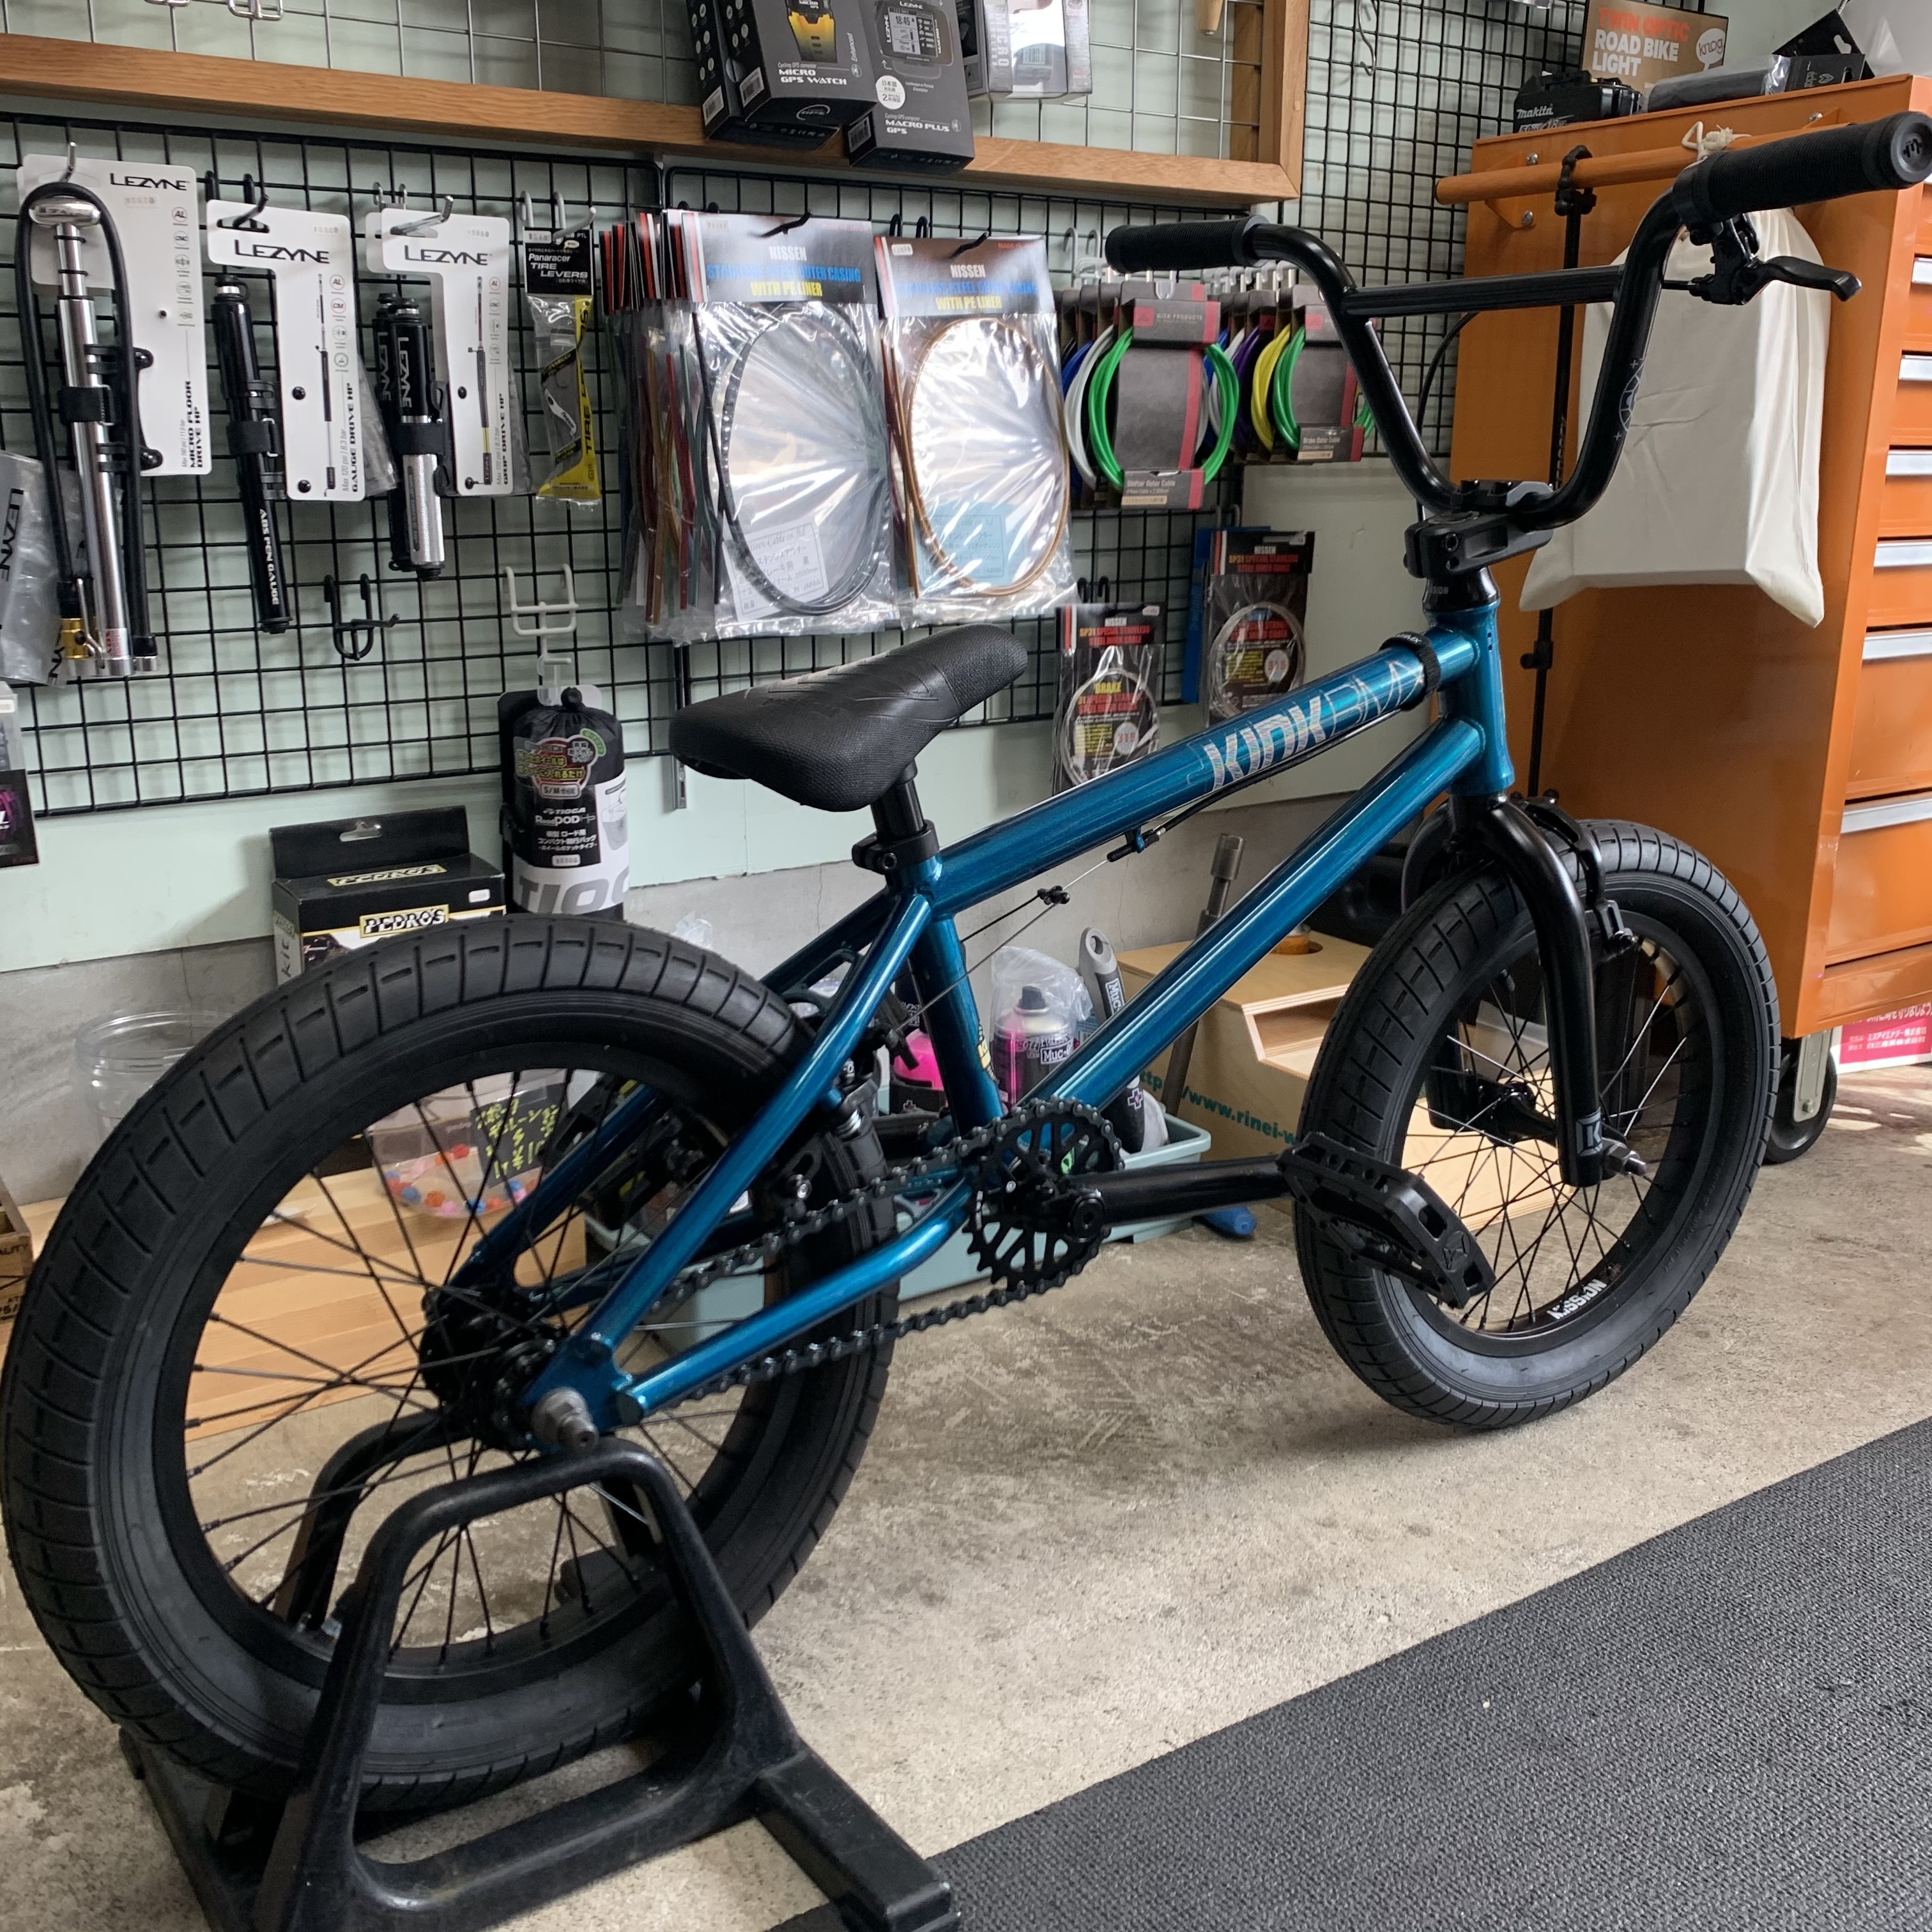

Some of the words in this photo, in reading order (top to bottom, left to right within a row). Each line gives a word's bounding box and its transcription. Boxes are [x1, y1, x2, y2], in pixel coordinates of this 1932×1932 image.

[900, 1, 923, 10] LEZYNE
[1598, 7, 1640, 34] TWIN
[1643, 17, 1690, 42] OPTIC
[995, 13, 1009, 67] MICRO
[1595, 29, 1642, 56] ROAD
[1643, 37, 1680, 62] BIKE
[1699, 38, 1724, 57] knog
[1592, 51, 1642, 77] LIGHT
[1516, 105, 1554, 119] makita
[885, 119, 923, 128] MACRO
[924, 123, 950, 132] PLUS
[110, 172, 190, 191] LEZYNE
[234, 240, 330, 264] LEZYNE
[404, 245, 488, 266] LEZYNE
[528, 253, 571, 262] Panaracer
[769, 245, 808, 261] NISSEN
[540, 270, 588, 279] LEVERS
[799, 265, 827, 281] OUTER
[828, 266, 861, 283] CASING
[950, 264, 986, 278] NISSEN
[750, 281, 781, 296] WITH
[783, 281, 795, 296] PE
[797, 282, 823, 296] LINER
[935, 296, 963, 310] WITH
[964, 296, 976, 309] PE
[976, 296, 1002, 309] LINER
[397, 337, 412, 408] LEZYNE
[347, 383, 353, 400] HP
[194, 407, 201, 424] HP
[348, 403, 356, 444] DRIVE
[341, 455, 350, 464] psi
[350, 448, 358, 492] GAUGE
[0, 488, 24, 582] LEZYNE
[264, 537, 273, 561] PEN
[1254, 546, 1276, 555] NISSEN
[267, 563, 280, 605] GAUGE
[1105, 617, 1127, 627] NISSEN
[1080, 627, 1096, 637] SP31
[1095, 682, 1121, 694] BRAKE
[1203, 696, 1326, 791] KINK
[365, 908, 445, 933] PEDRO'S
